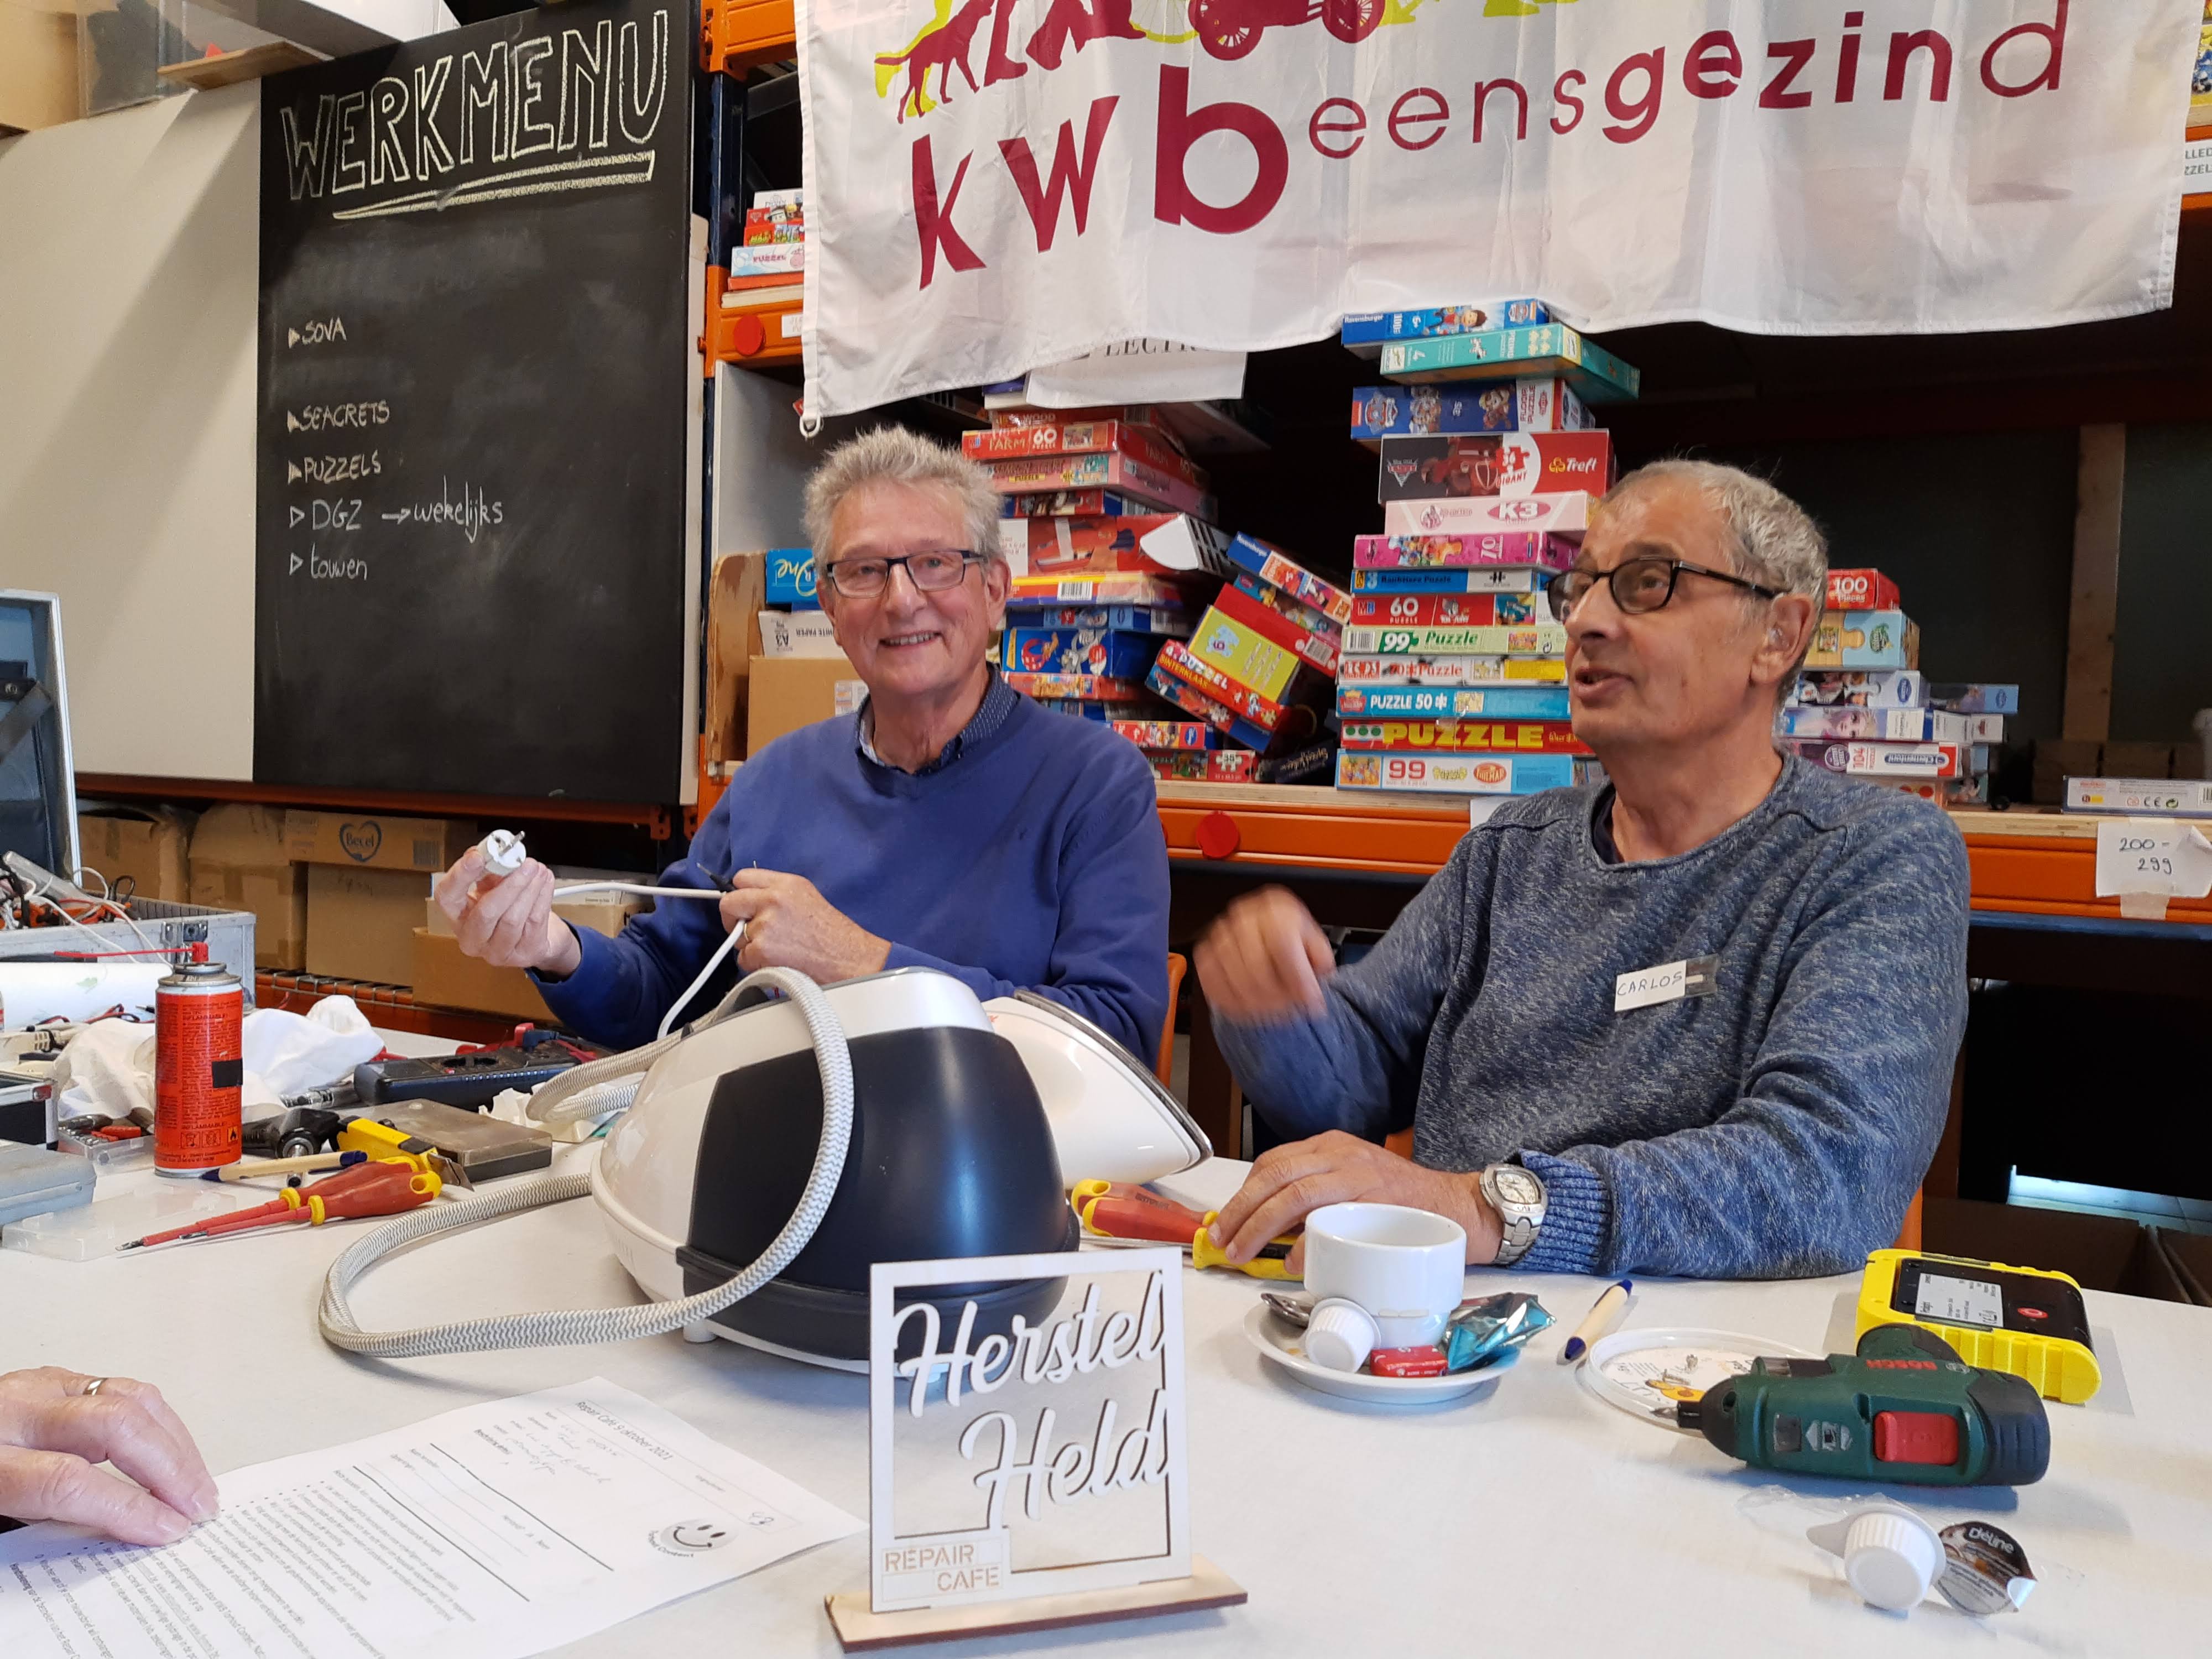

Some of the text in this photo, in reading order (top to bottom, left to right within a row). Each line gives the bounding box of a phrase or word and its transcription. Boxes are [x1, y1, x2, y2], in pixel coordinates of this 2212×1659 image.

[280, 10, 668, 200] WERKMENU
[302, 317, 347, 345] SOVA
[1344, 313, 1384, 324] Ravensburger
[299, 399, 390, 432] SEACRETS
[1034, 427, 1057, 445] 60
[304, 450, 382, 485] PUZZELS
[1566, 457, 1597, 473] Trefl
[312, 474, 503, 544] DGZ wekelijks
[1499, 501, 1540, 519] K3
[1833, 576, 1868, 594] 100
[1390, 597, 1420, 617] 60
[1389, 616, 1418, 624] PUZZLE
[817, 628, 833, 638] HITE
[1383, 630, 1479, 653] 99 Puzzle
[1160, 655, 1211, 688] SINTERKLAAS
[1370, 694, 1412, 710] PUZZLE
[1415, 693, 1433, 710] 50
[1382, 722, 1545, 749] PUZZLE
[1389, 759, 1427, 780] 99
[1617, 971, 1683, 996] CARLOS
[893, 1270, 1166, 1418] Herstel
[575, 1401, 601, 1416] Repair
[619, 1429, 653, 1447] oktober
[648, 1446, 674, 1460] 2021
[958, 1388, 1170, 1528] Held
[884, 1543, 975, 1572] REPAIR
[937, 1566, 1000, 1592] CAFE
